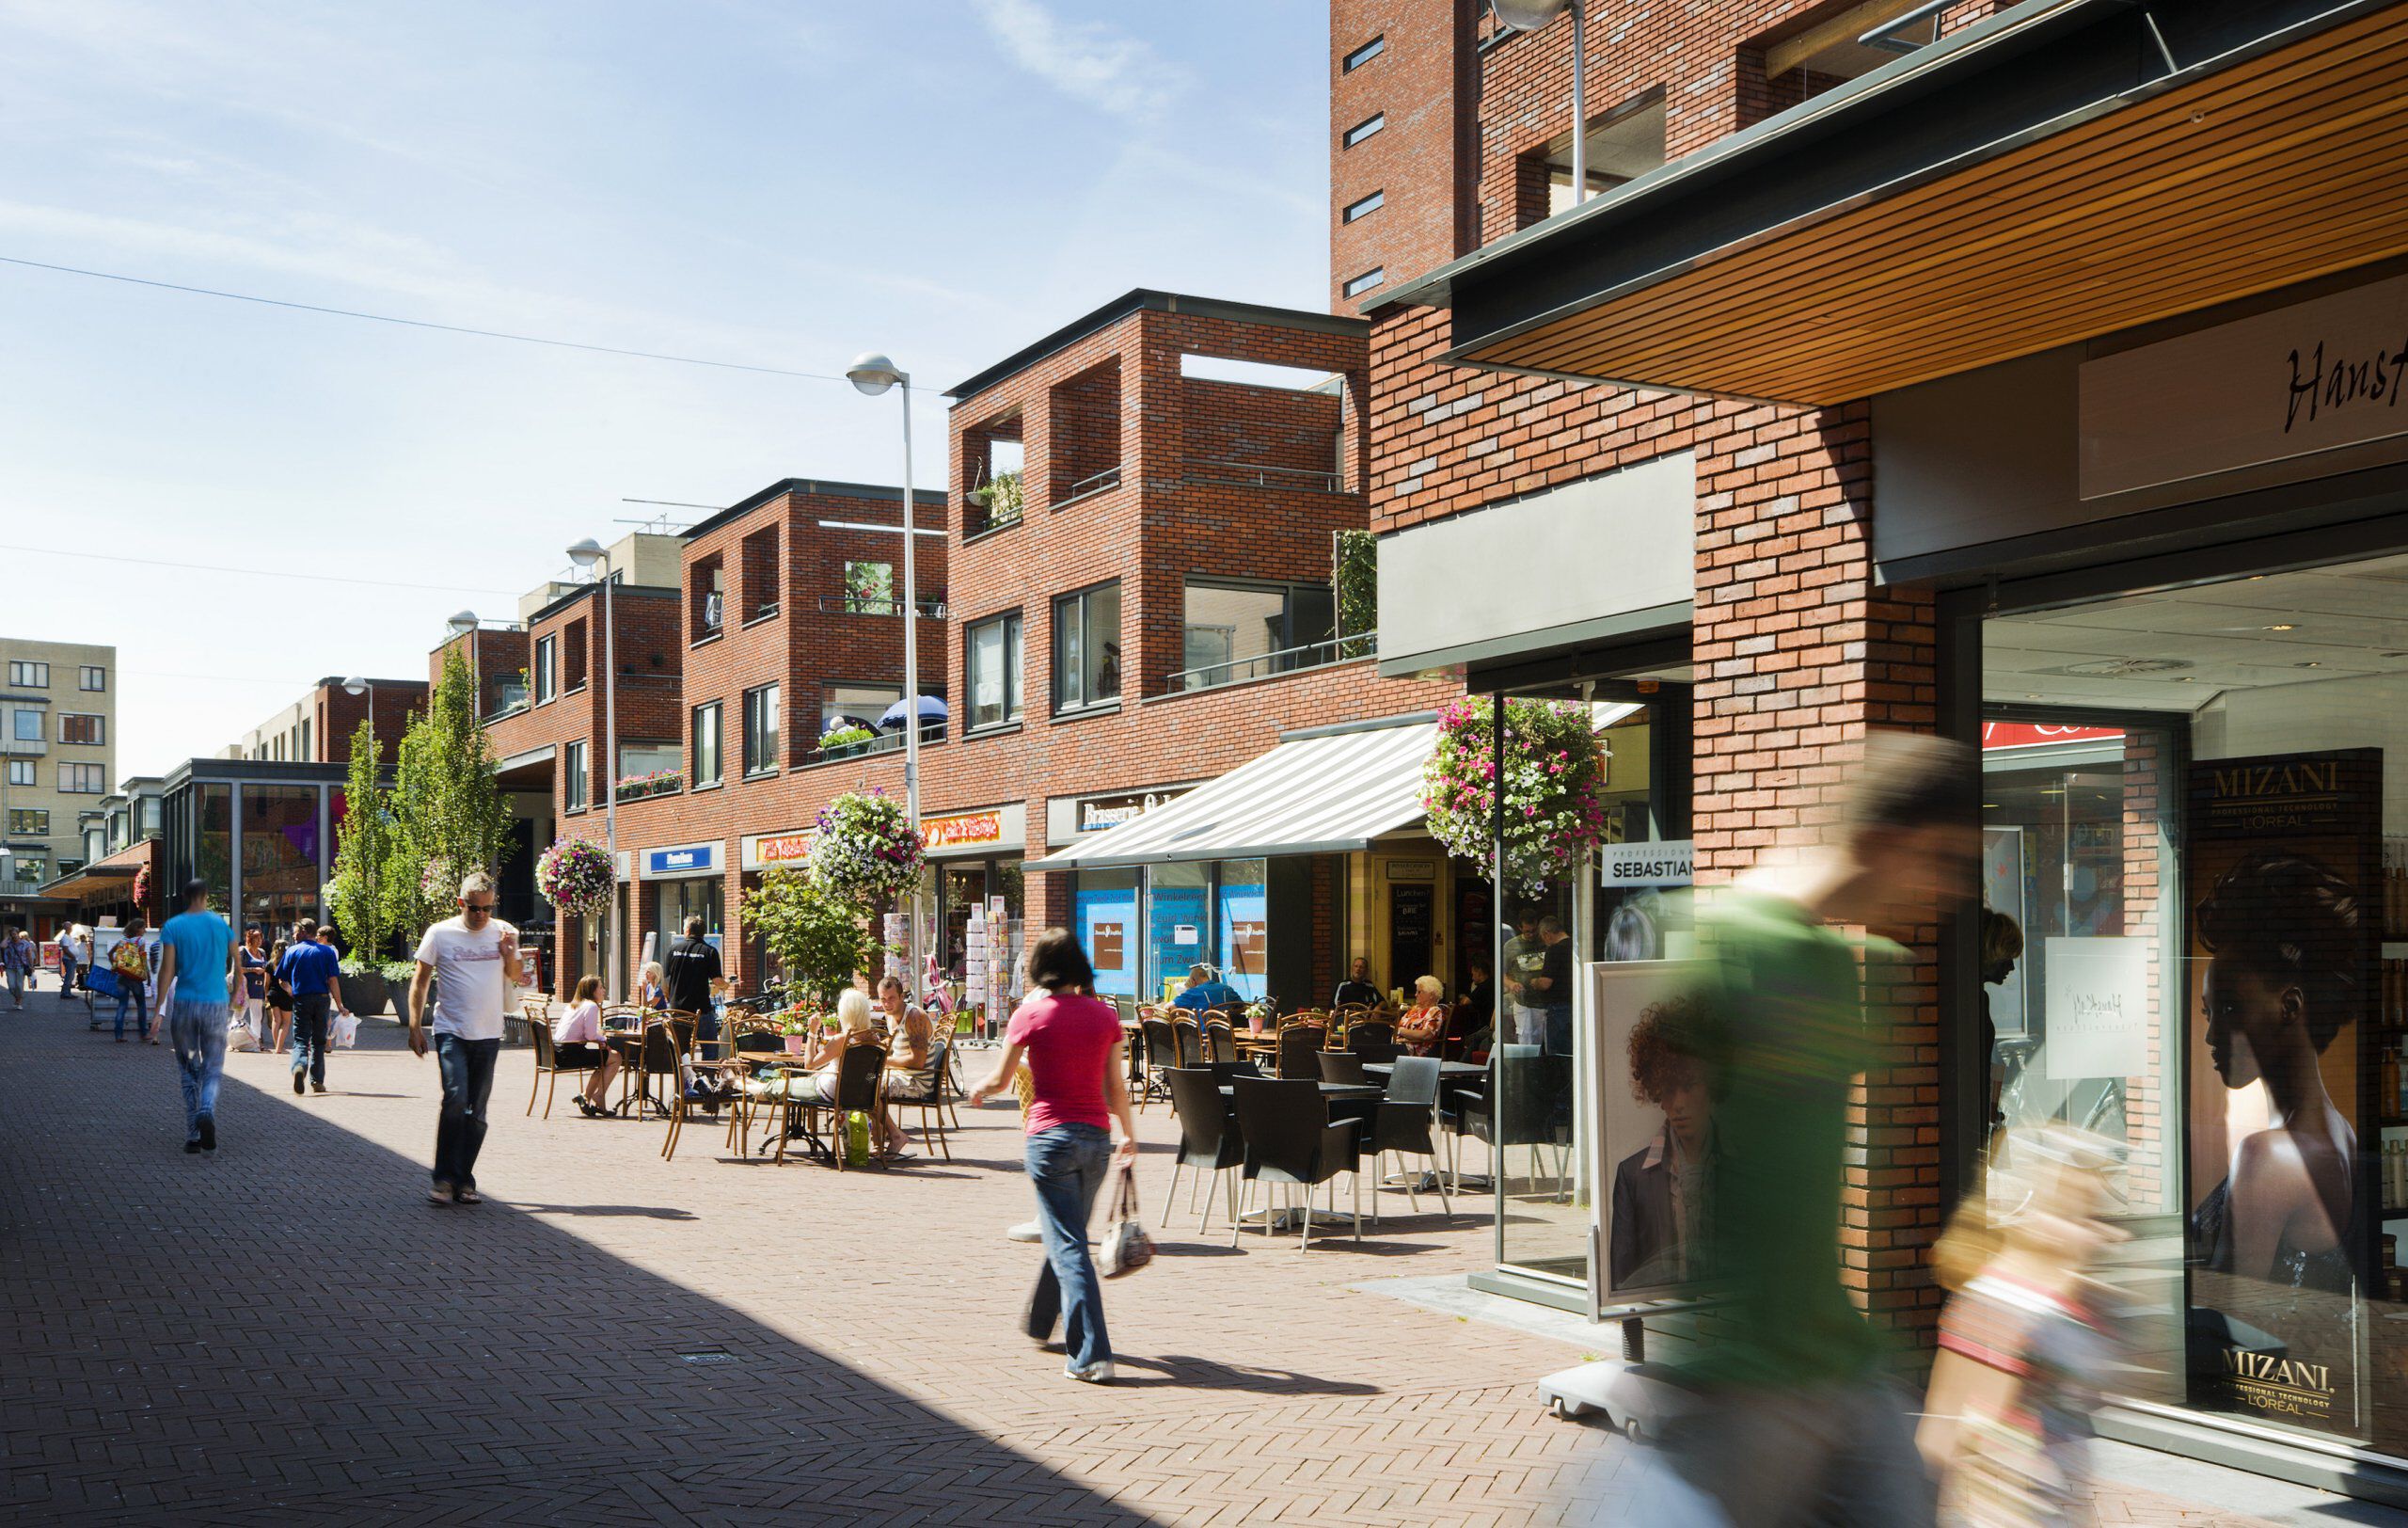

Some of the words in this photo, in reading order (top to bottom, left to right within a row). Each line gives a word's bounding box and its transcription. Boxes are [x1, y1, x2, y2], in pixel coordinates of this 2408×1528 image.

[2212, 761, 2338, 798] MIZANI
[1084, 803, 1140, 824] Brasserie
[2278, 1393, 2330, 1409] TECHNOLOGY
